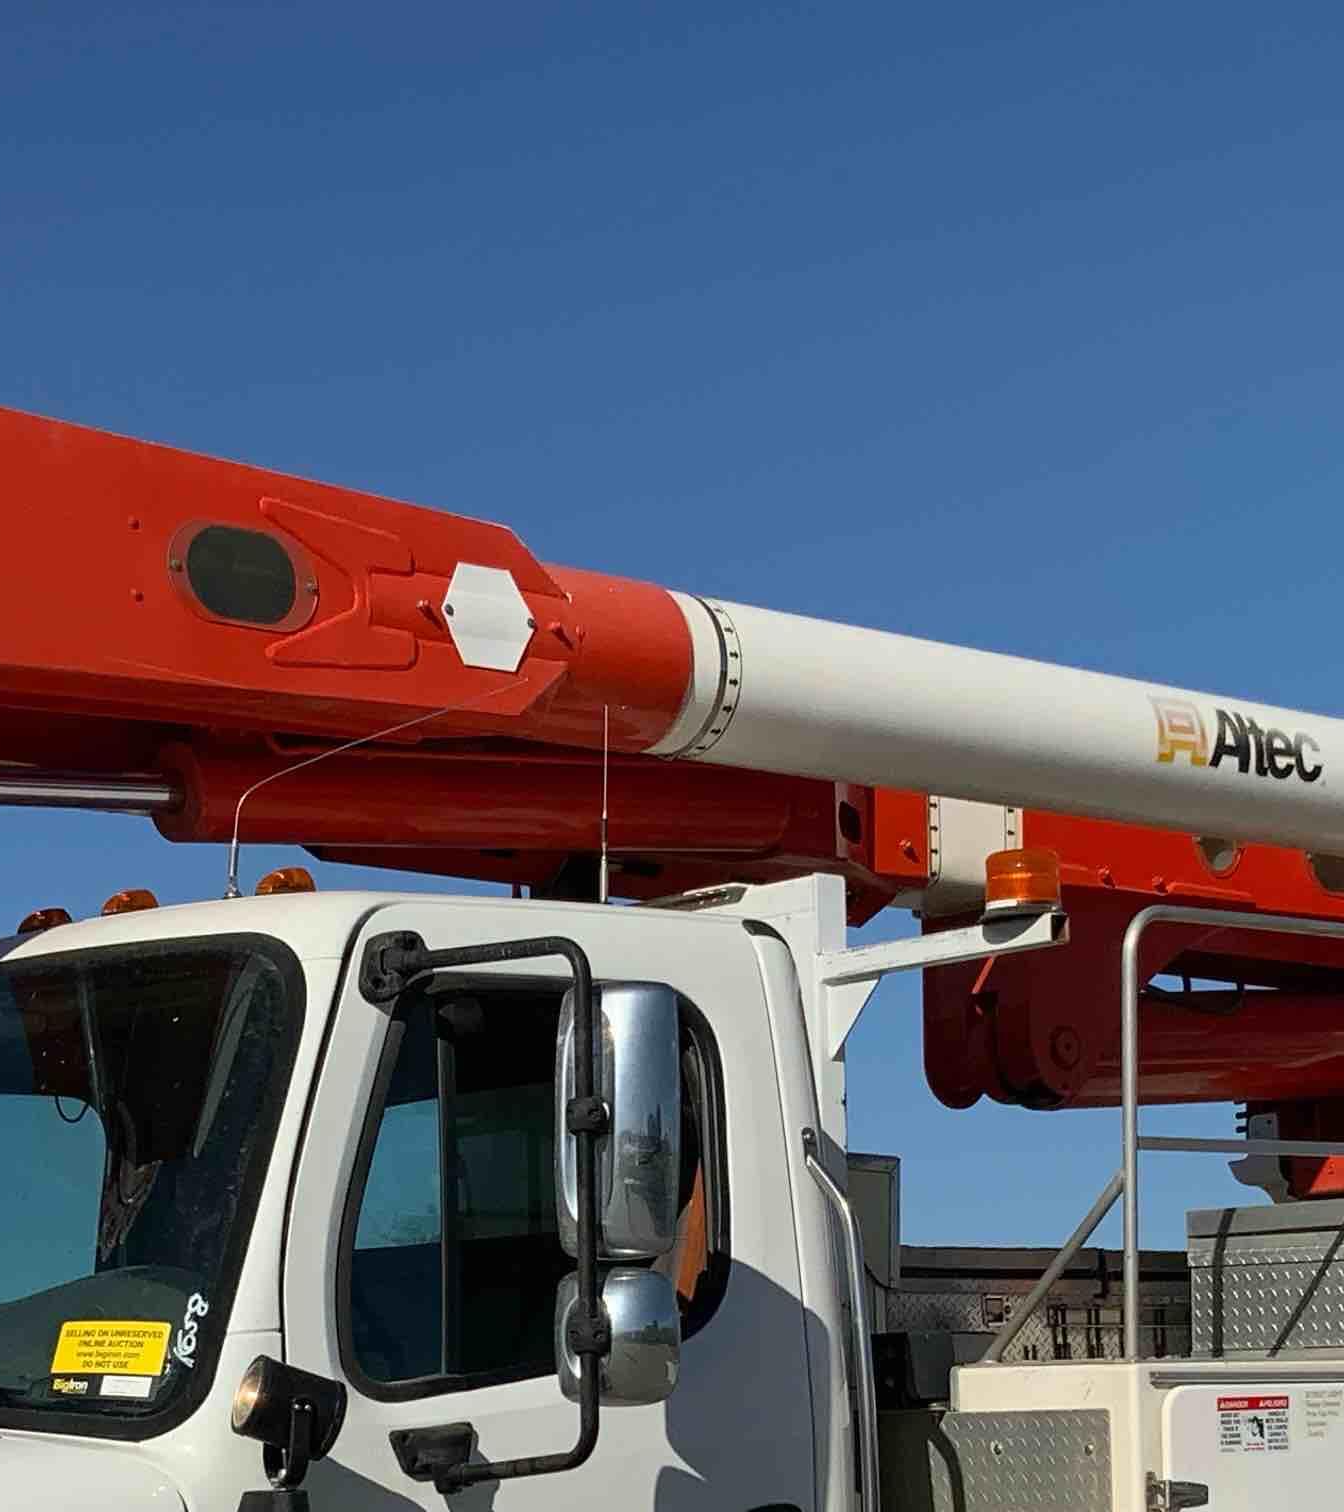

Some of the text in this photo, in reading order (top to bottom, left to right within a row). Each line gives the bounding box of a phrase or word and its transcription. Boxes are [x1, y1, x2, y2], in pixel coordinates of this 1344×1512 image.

[1209, 708, 1324, 782] Altec
[107, 1340, 145, 1348] AUCTION
[94, 1360, 111, 1368] NOT
